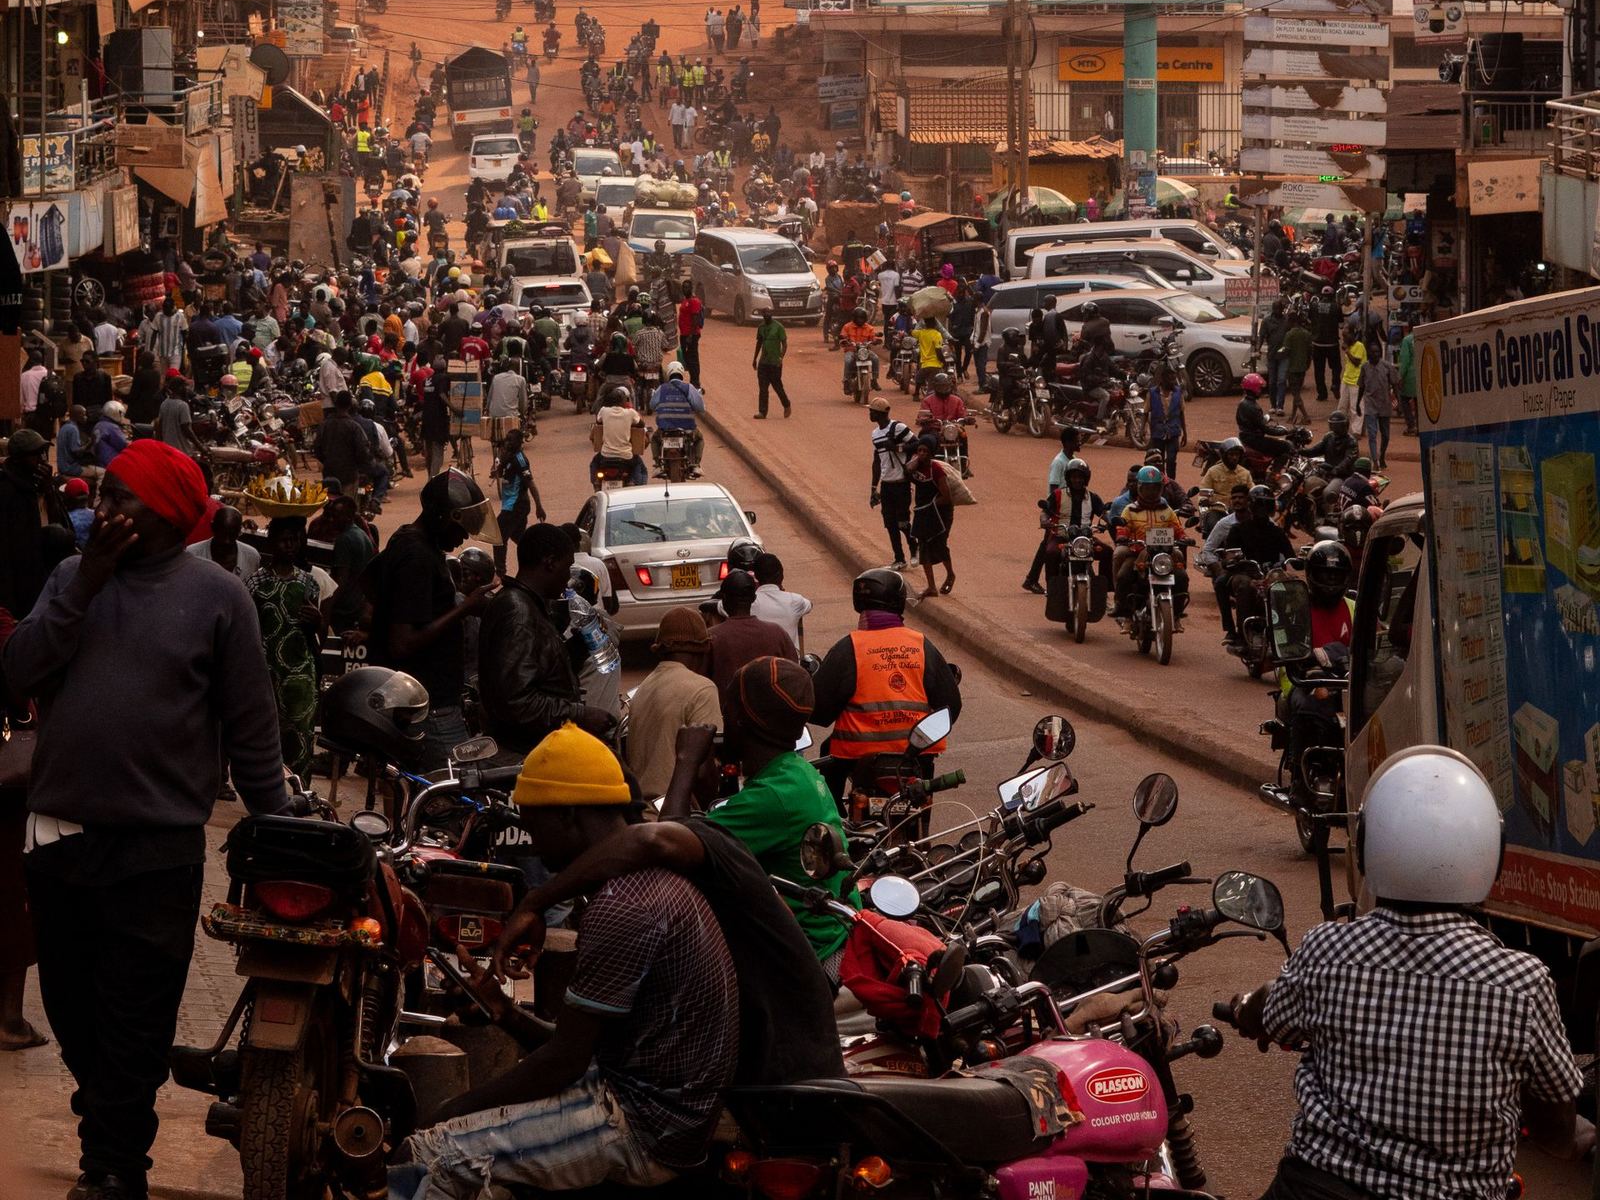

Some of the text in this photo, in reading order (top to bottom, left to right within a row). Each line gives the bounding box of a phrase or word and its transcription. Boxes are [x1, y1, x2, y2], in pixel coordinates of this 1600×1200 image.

[1173, 59, 1213, 70] Centre
[1283, 184, 1303, 192] ROKO
[1440, 338, 1493, 397] Prime
[1496, 317, 1573, 389] General
[1522, 391, 1543, 414] House
[1553, 386, 1576, 416] Paper
[343, 645, 367, 659] NO
[880, 653, 909, 662] Uganda
[900, 645, 920, 654] Cargo
[1495, 864, 1527, 895] ganda's
[1529, 866, 1545, 892] One
[1547, 872, 1567, 911] Stop
[1095, 1076, 1143, 1095] PLASCON
[1091, 1110, 1157, 1127] COLOUR YOUR WORLD
[1029, 1180, 1053, 1196] PAINT
